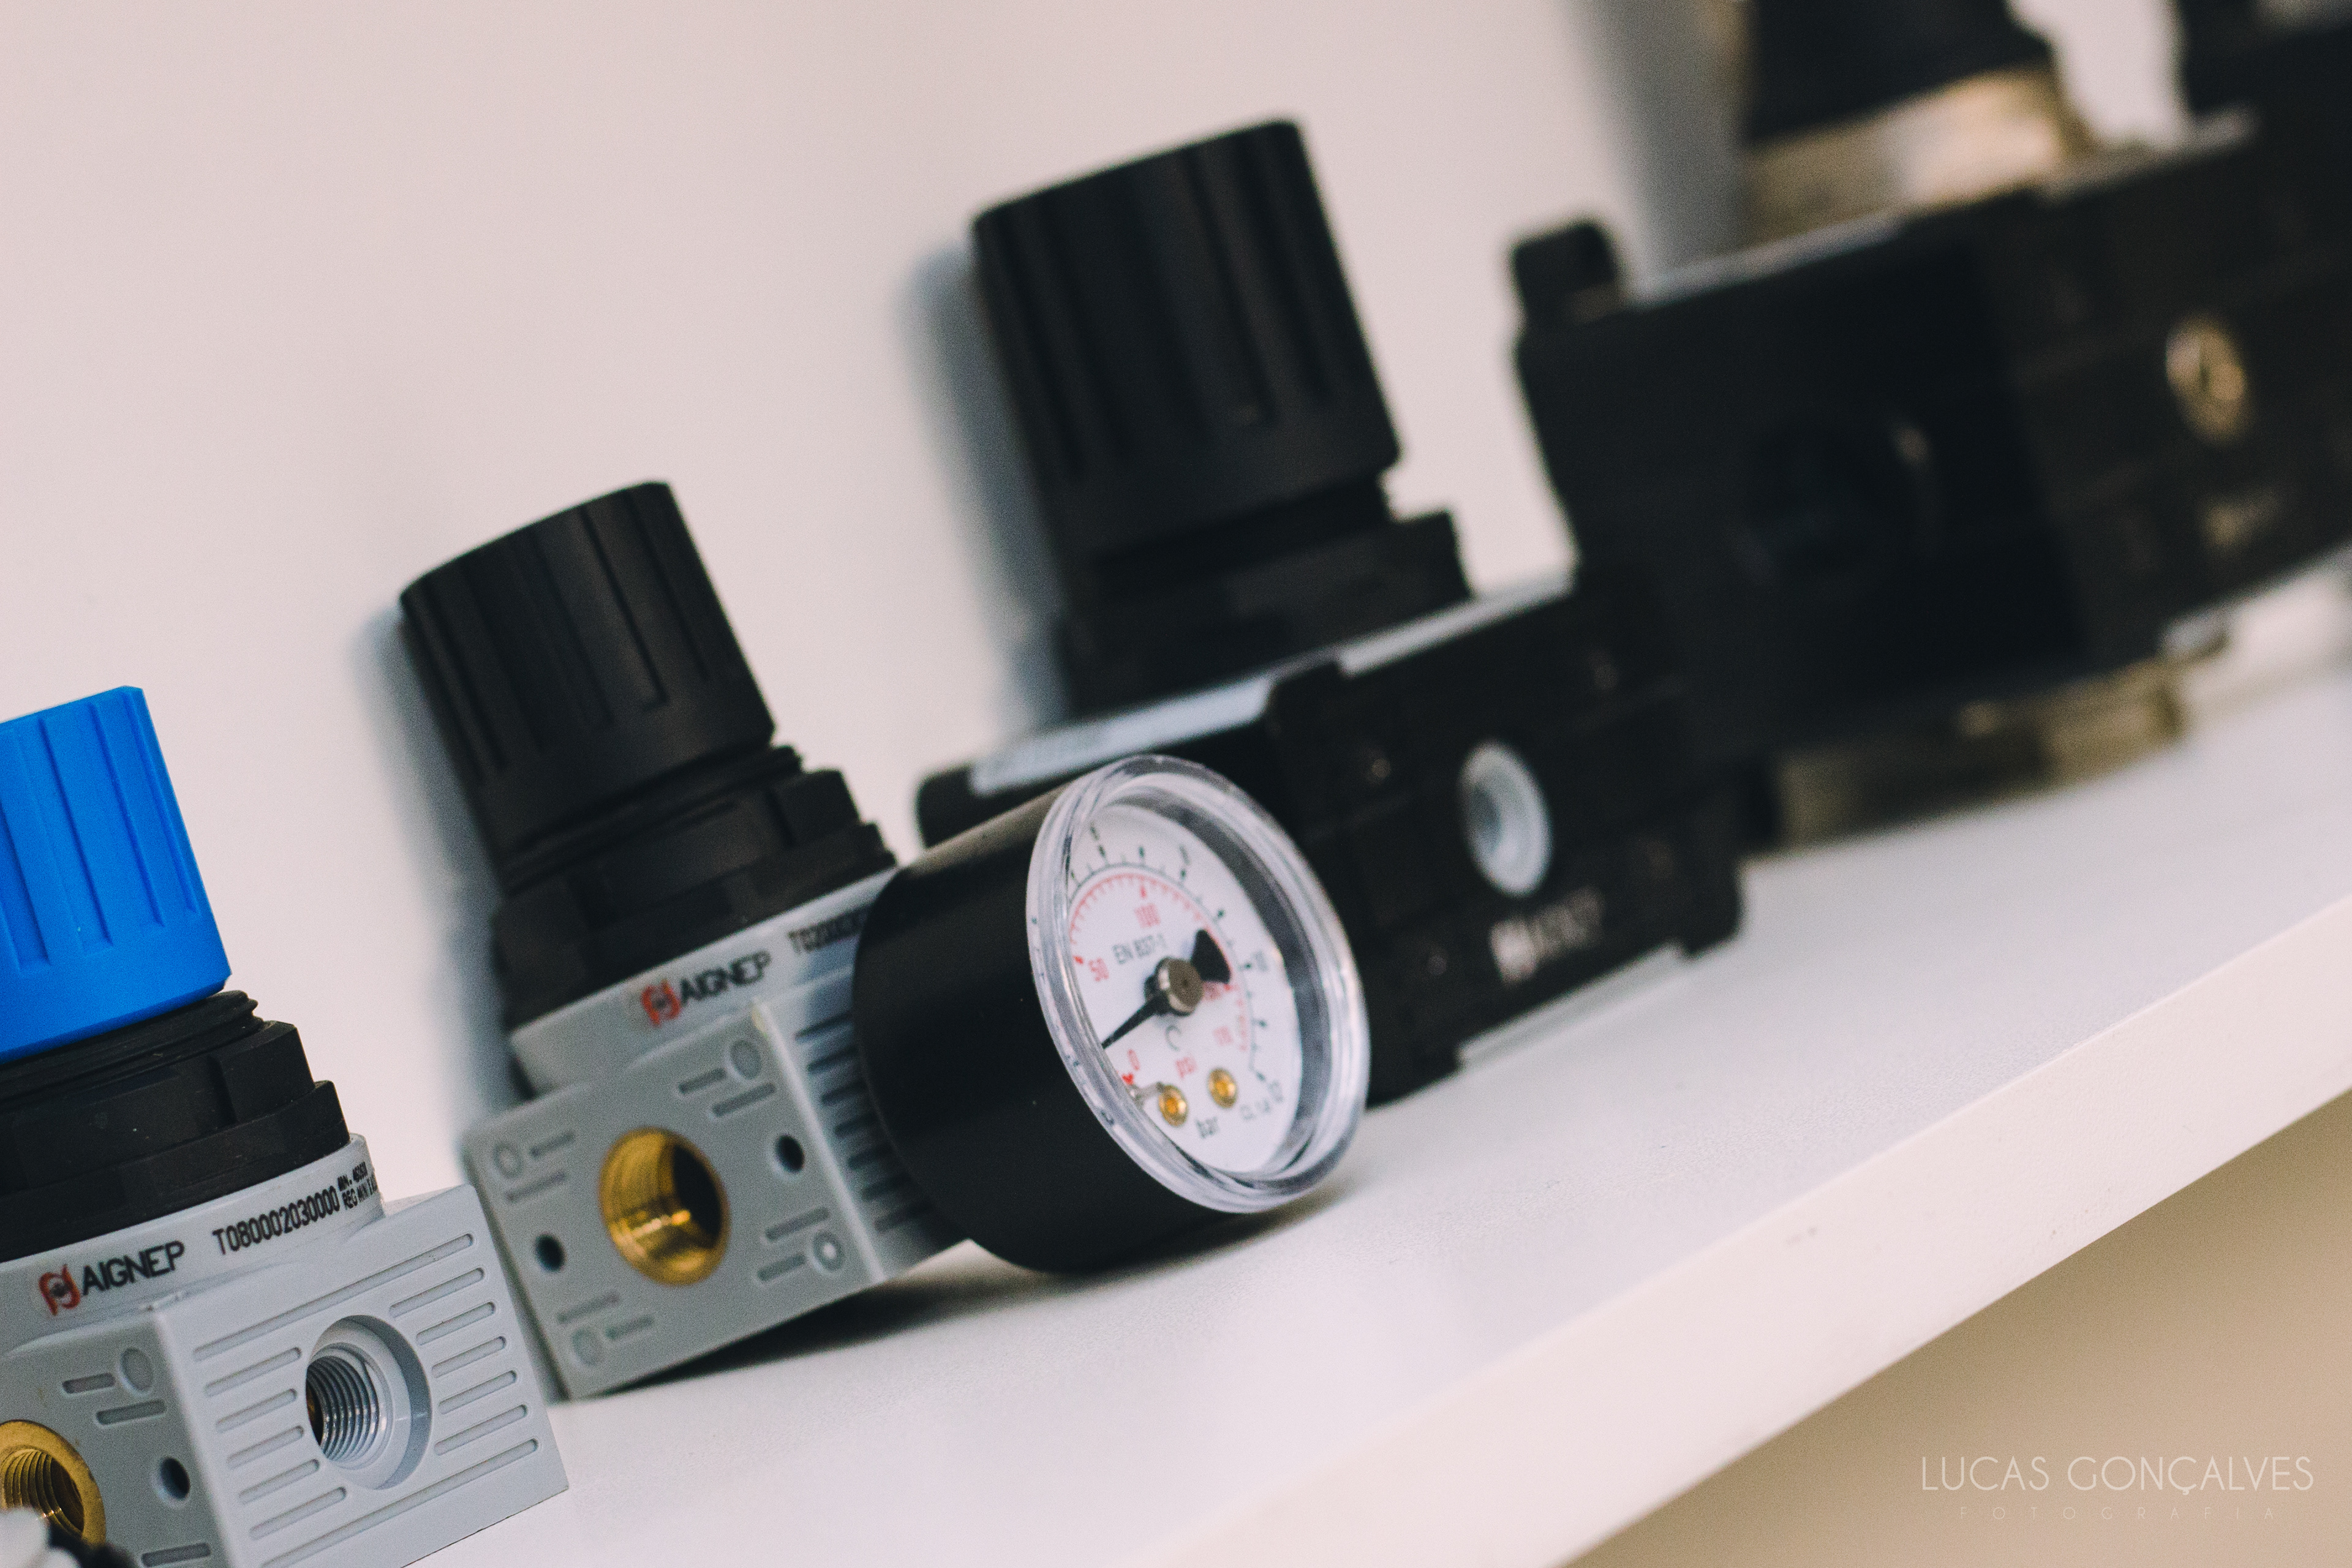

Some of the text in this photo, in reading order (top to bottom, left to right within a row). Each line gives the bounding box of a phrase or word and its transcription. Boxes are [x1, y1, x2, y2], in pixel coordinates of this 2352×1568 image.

[1111, 943, 1134, 966] EN
[1088, 958, 1110, 982] 50
[1126, 1049, 1140, 1071] 0
[83, 1185, 341, 1296] AIGNEP T080002030000
